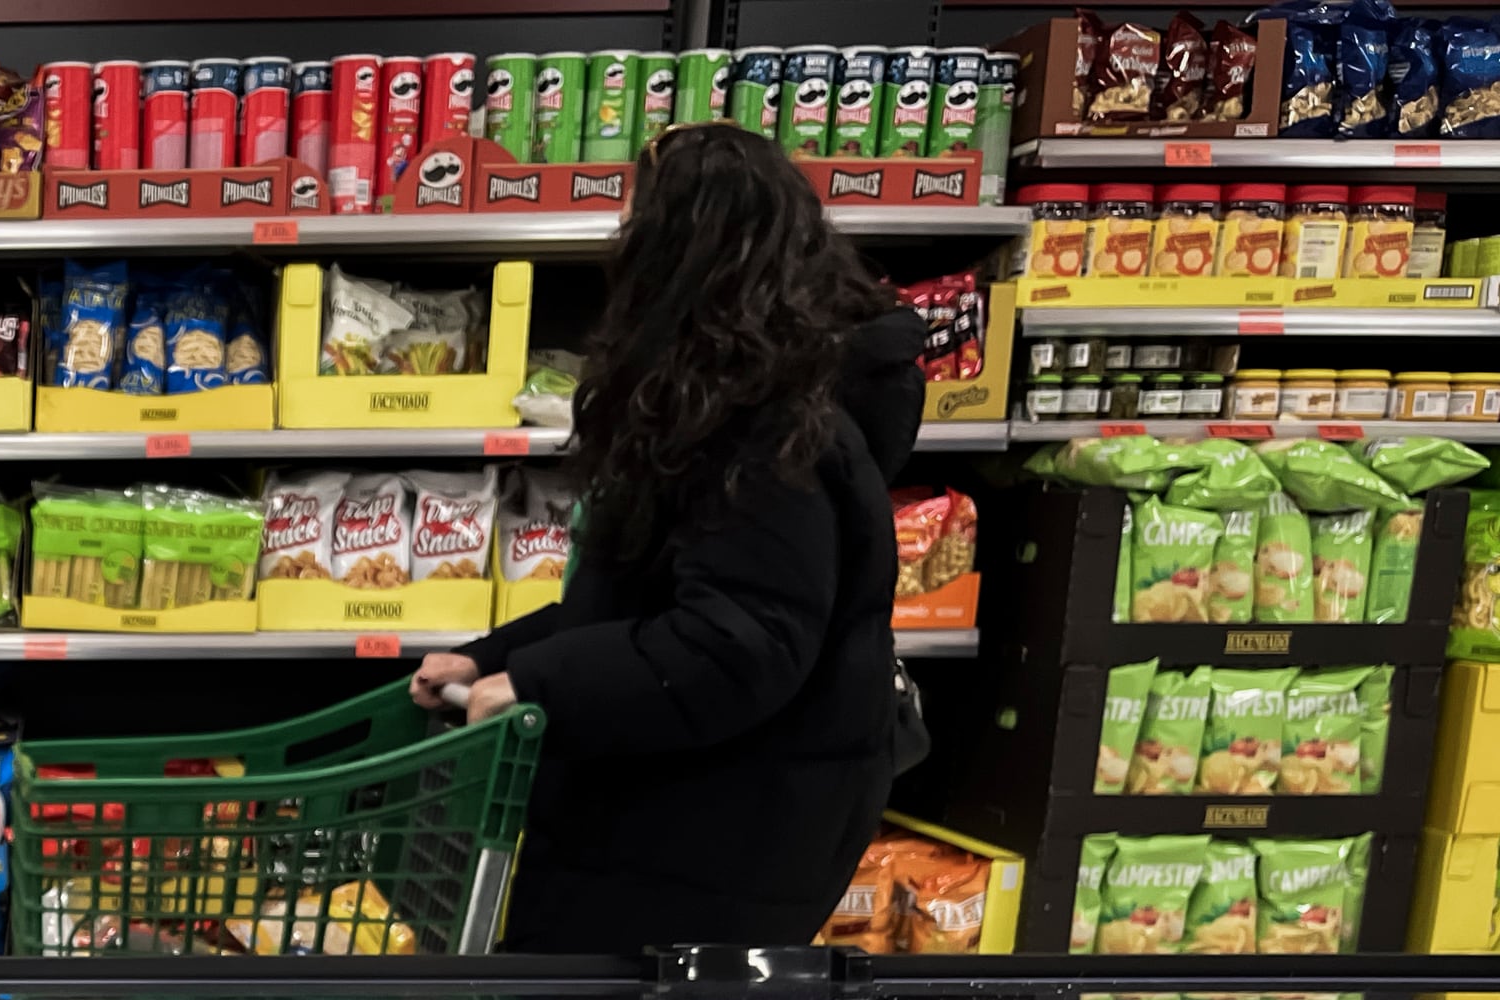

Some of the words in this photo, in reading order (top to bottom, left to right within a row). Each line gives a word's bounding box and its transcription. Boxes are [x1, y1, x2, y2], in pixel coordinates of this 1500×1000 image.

[59, 184, 106, 207] PRINGLES
[141, 181, 189, 207] PRINGLES
[224, 180, 271, 205] PRINGLES
[418, 185, 461, 207] PRINGLES
[490, 176, 538, 200] PRINGLES
[574, 175, 622, 200] PRINGLES
[831, 172, 881, 197] PRINGLES
[916, 172, 963, 197] PRINGLES
[335, 517, 400, 550] Snack
[345, 602, 401, 619] HACENDADO
